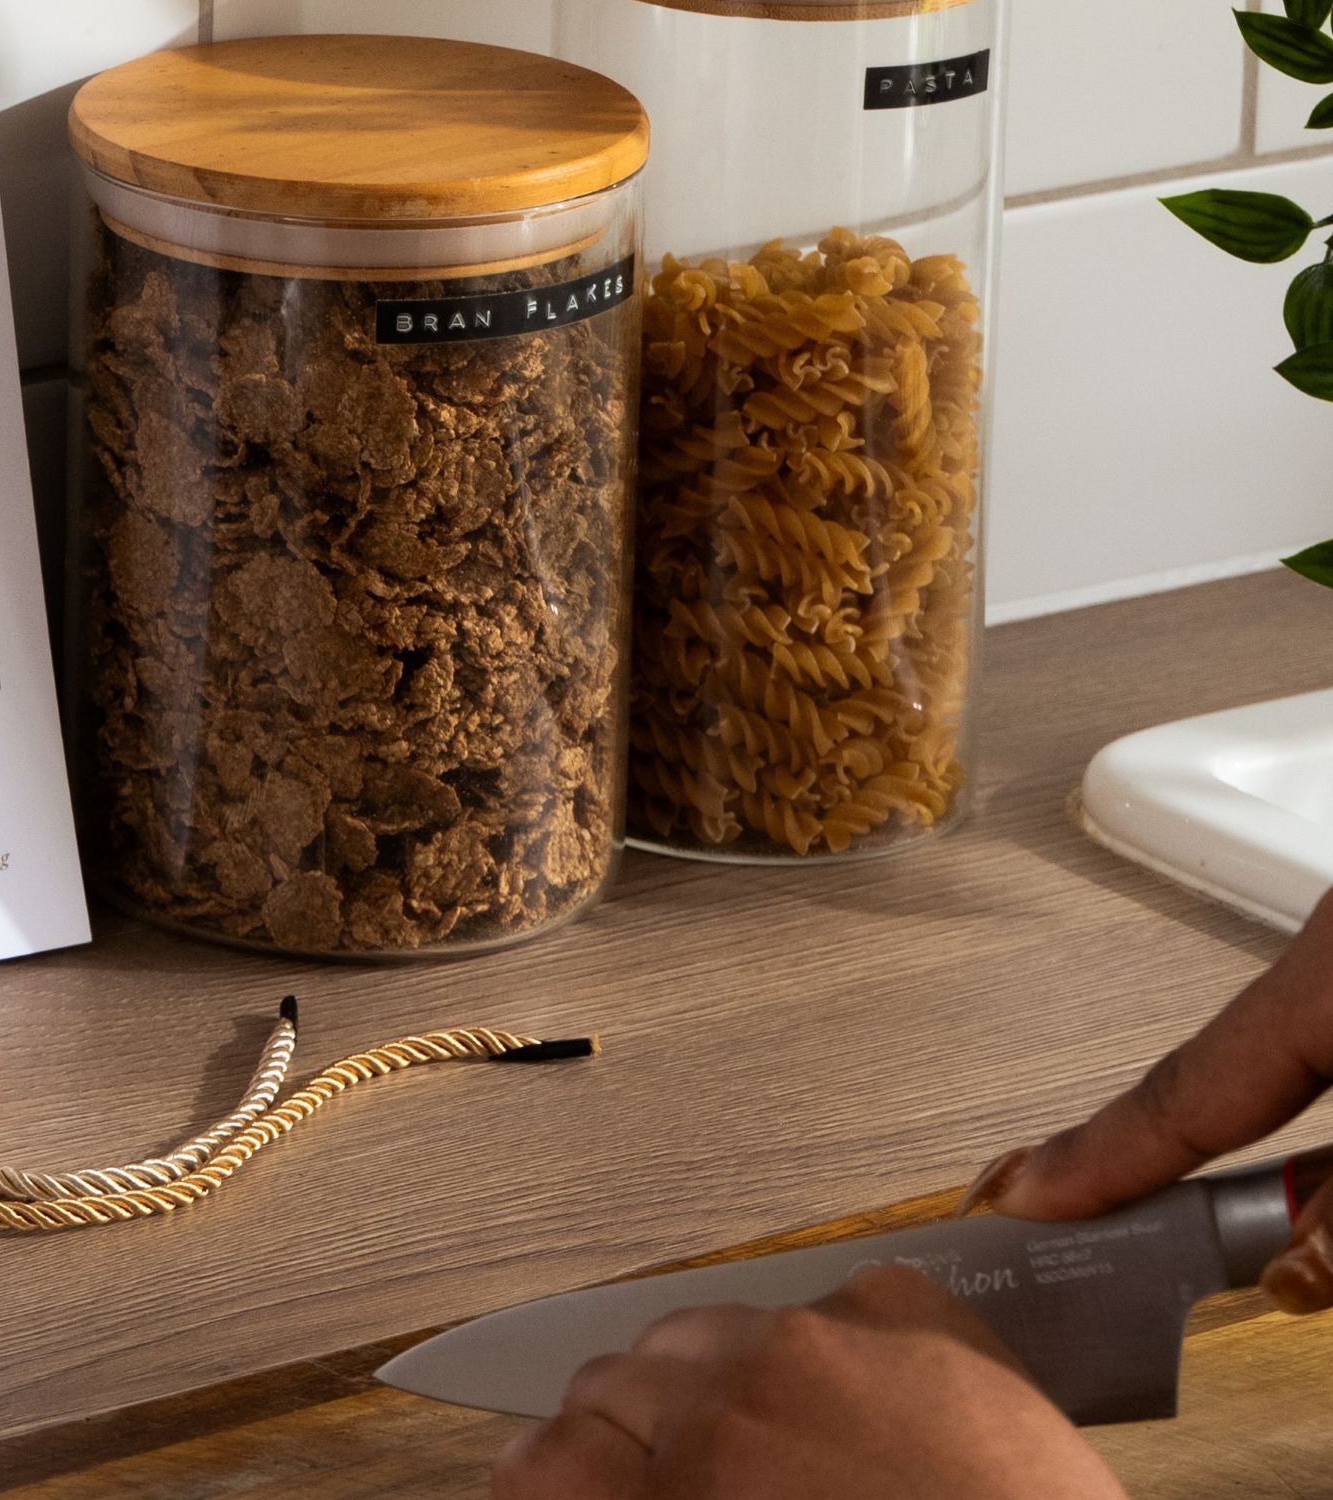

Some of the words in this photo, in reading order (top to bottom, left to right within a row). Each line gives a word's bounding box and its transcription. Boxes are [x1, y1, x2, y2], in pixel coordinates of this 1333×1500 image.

[879, 67, 976, 97] PASTA
[394, 308, 494, 335] BRAN
[524, 272, 626, 323] FLAKES
